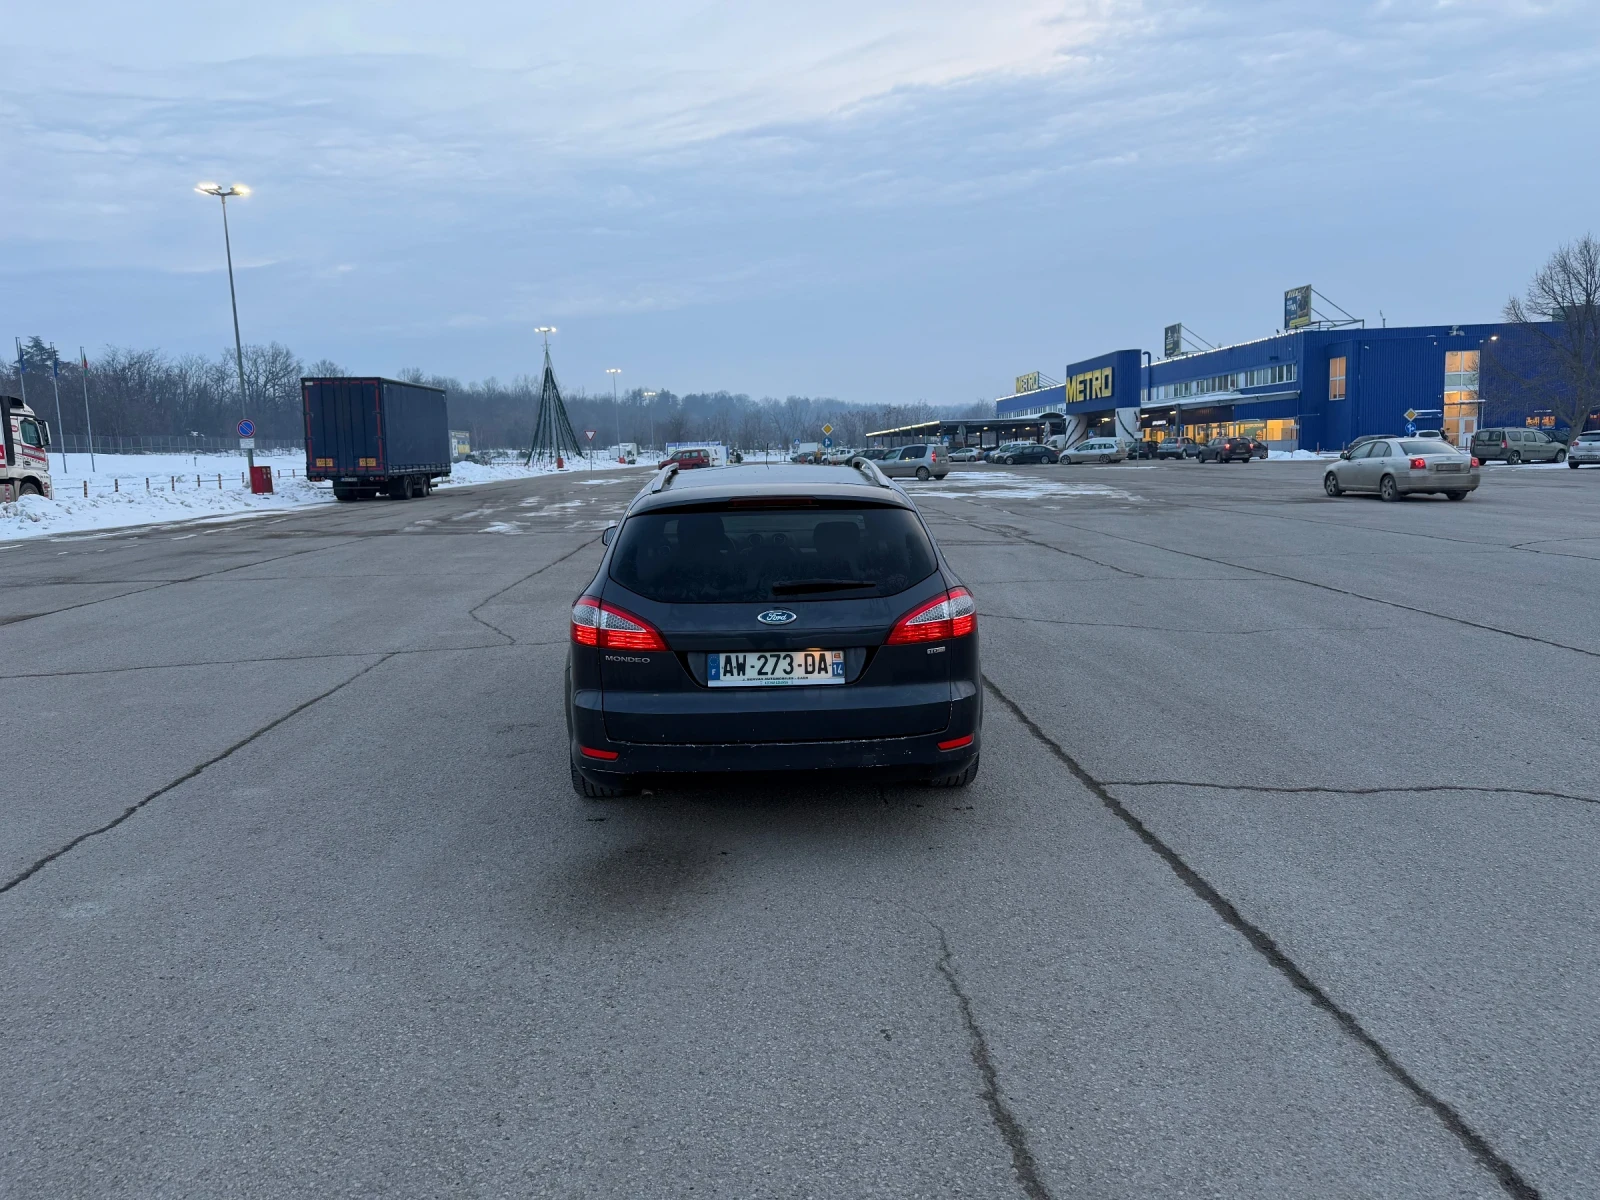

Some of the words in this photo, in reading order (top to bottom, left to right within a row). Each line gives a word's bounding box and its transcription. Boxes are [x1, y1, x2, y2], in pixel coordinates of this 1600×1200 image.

[1015, 371, 1039, 393] METRO
[1066, 367, 1112, 403] METRO
[767, 612, 787, 621] Ford
[605, 655, 651, 664] MONDEO
[723, 653, 829, 677] AW-273-DA
[711, 668, 716, 676] F
[833, 663, 843, 676] 14
